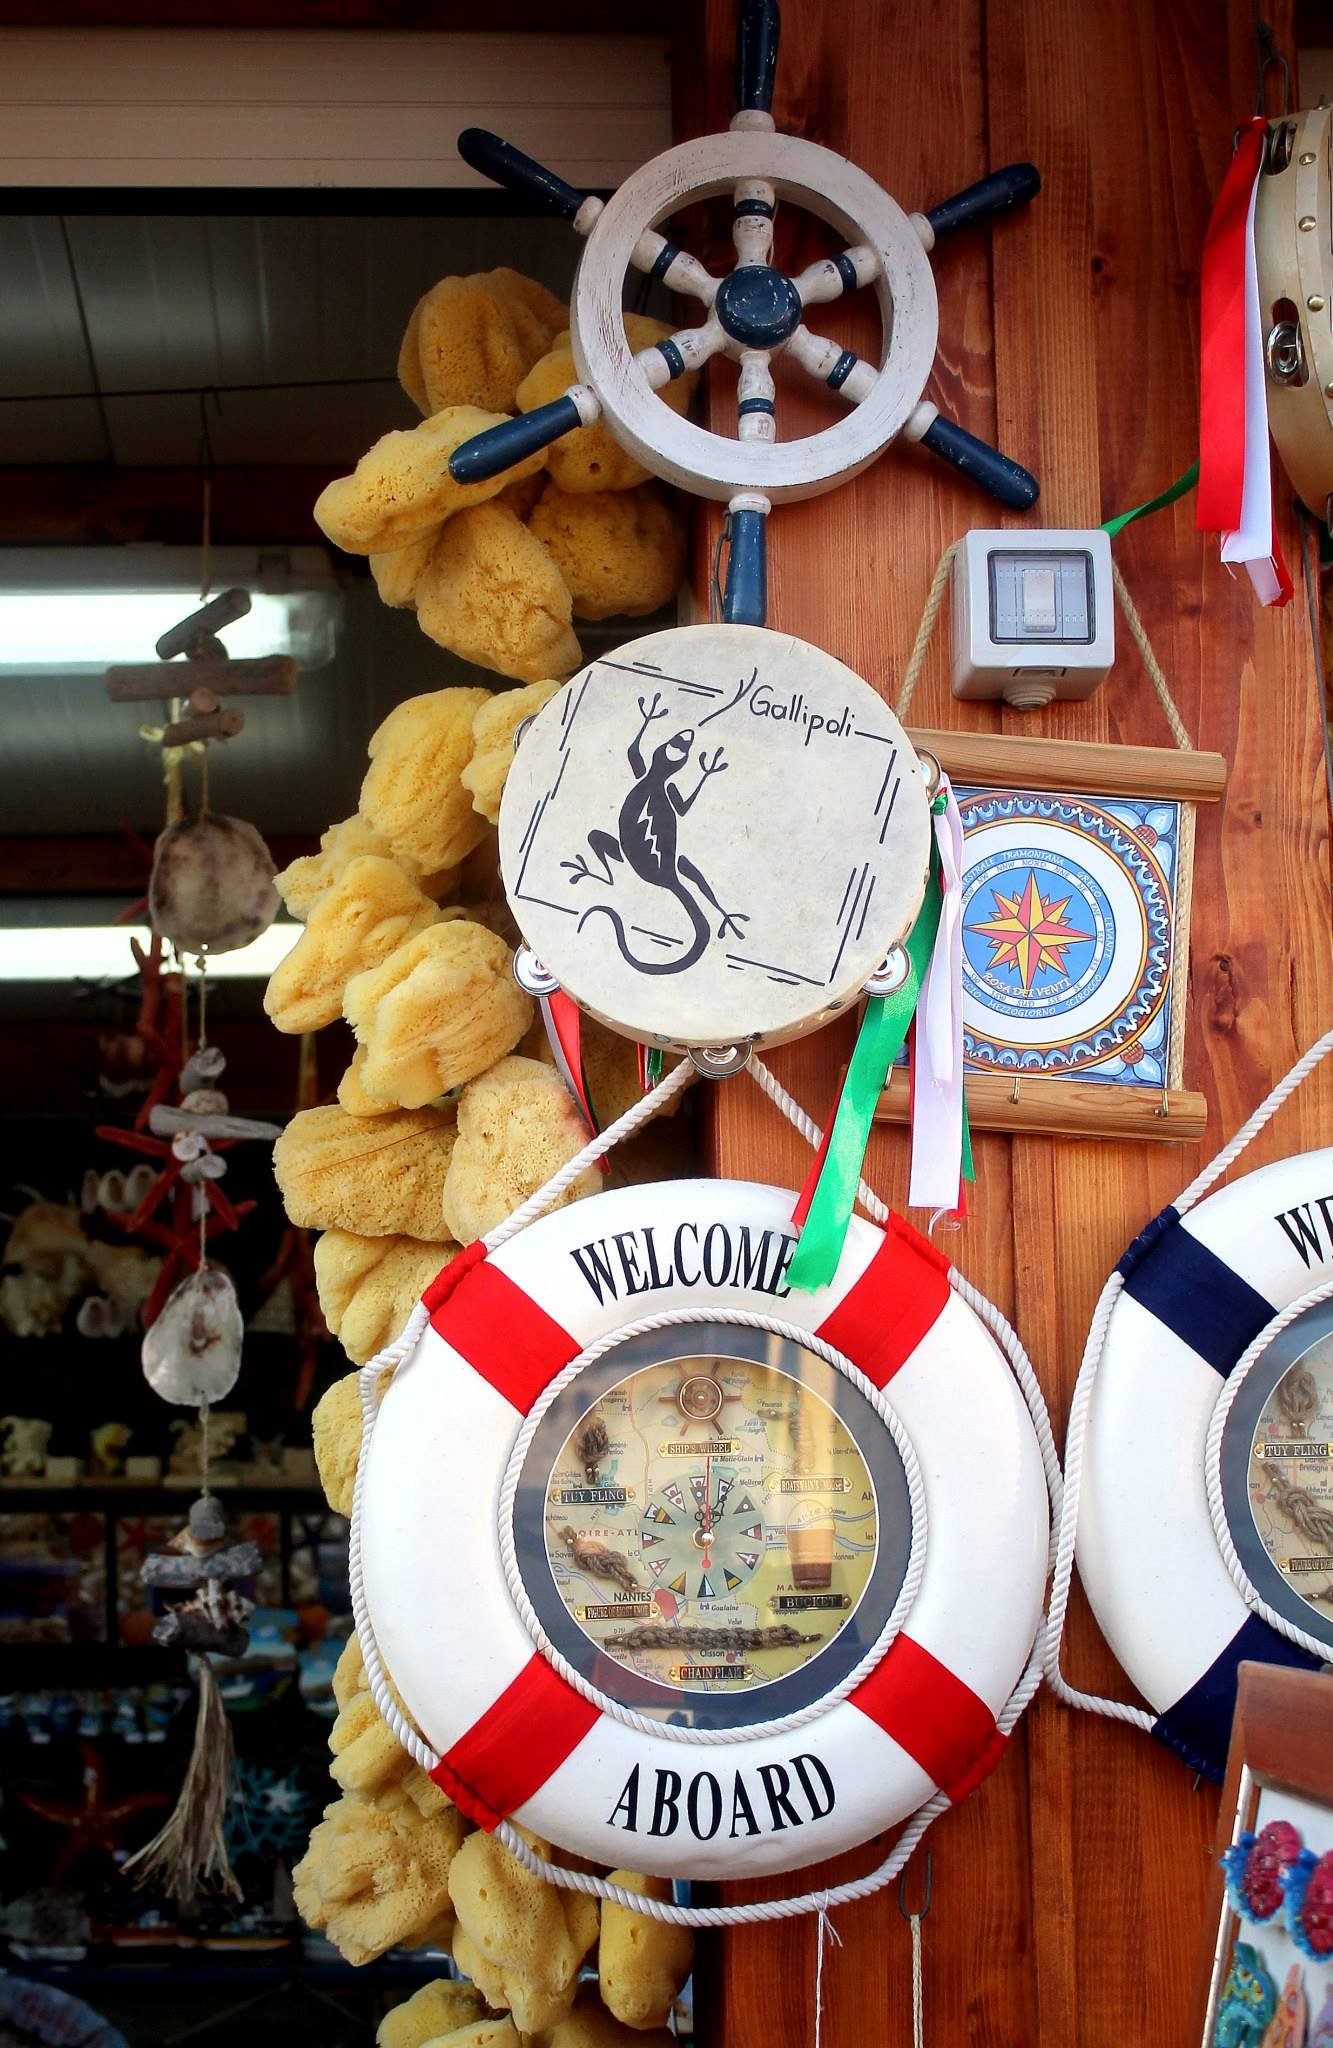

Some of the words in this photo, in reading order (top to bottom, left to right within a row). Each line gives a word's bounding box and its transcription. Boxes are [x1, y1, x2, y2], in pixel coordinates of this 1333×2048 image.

[750, 685, 855, 746] Gallipoli
[1022, 860, 1047, 868] NORD
[1002, 850, 1065, 866] TRAMONTANA
[1104, 916, 1113, 961] LEVANTE
[983, 972, 1010, 995] ROSA
[1036, 977, 1071, 997] VENTI
[987, 999, 1056, 1017] MEZZOGIORNO
[1066, 974, 1102, 1009] SCIROCCO
[569, 1222, 800, 1307] WELCOME
[699, 1443, 730, 1453] WHEEL
[1266, 1445, 1289, 1457] TUY
[1294, 1445, 1327, 1456] FLING
[562, 1491, 586, 1502] TUY
[591, 1489, 624, 1501] FLING
[614, 1592, 651, 1602] NANTES
[786, 1596, 836, 1607] BUCKET
[680, 1667, 712, 1679] CHAIN
[606, 1753, 836, 1841] ABOARD
